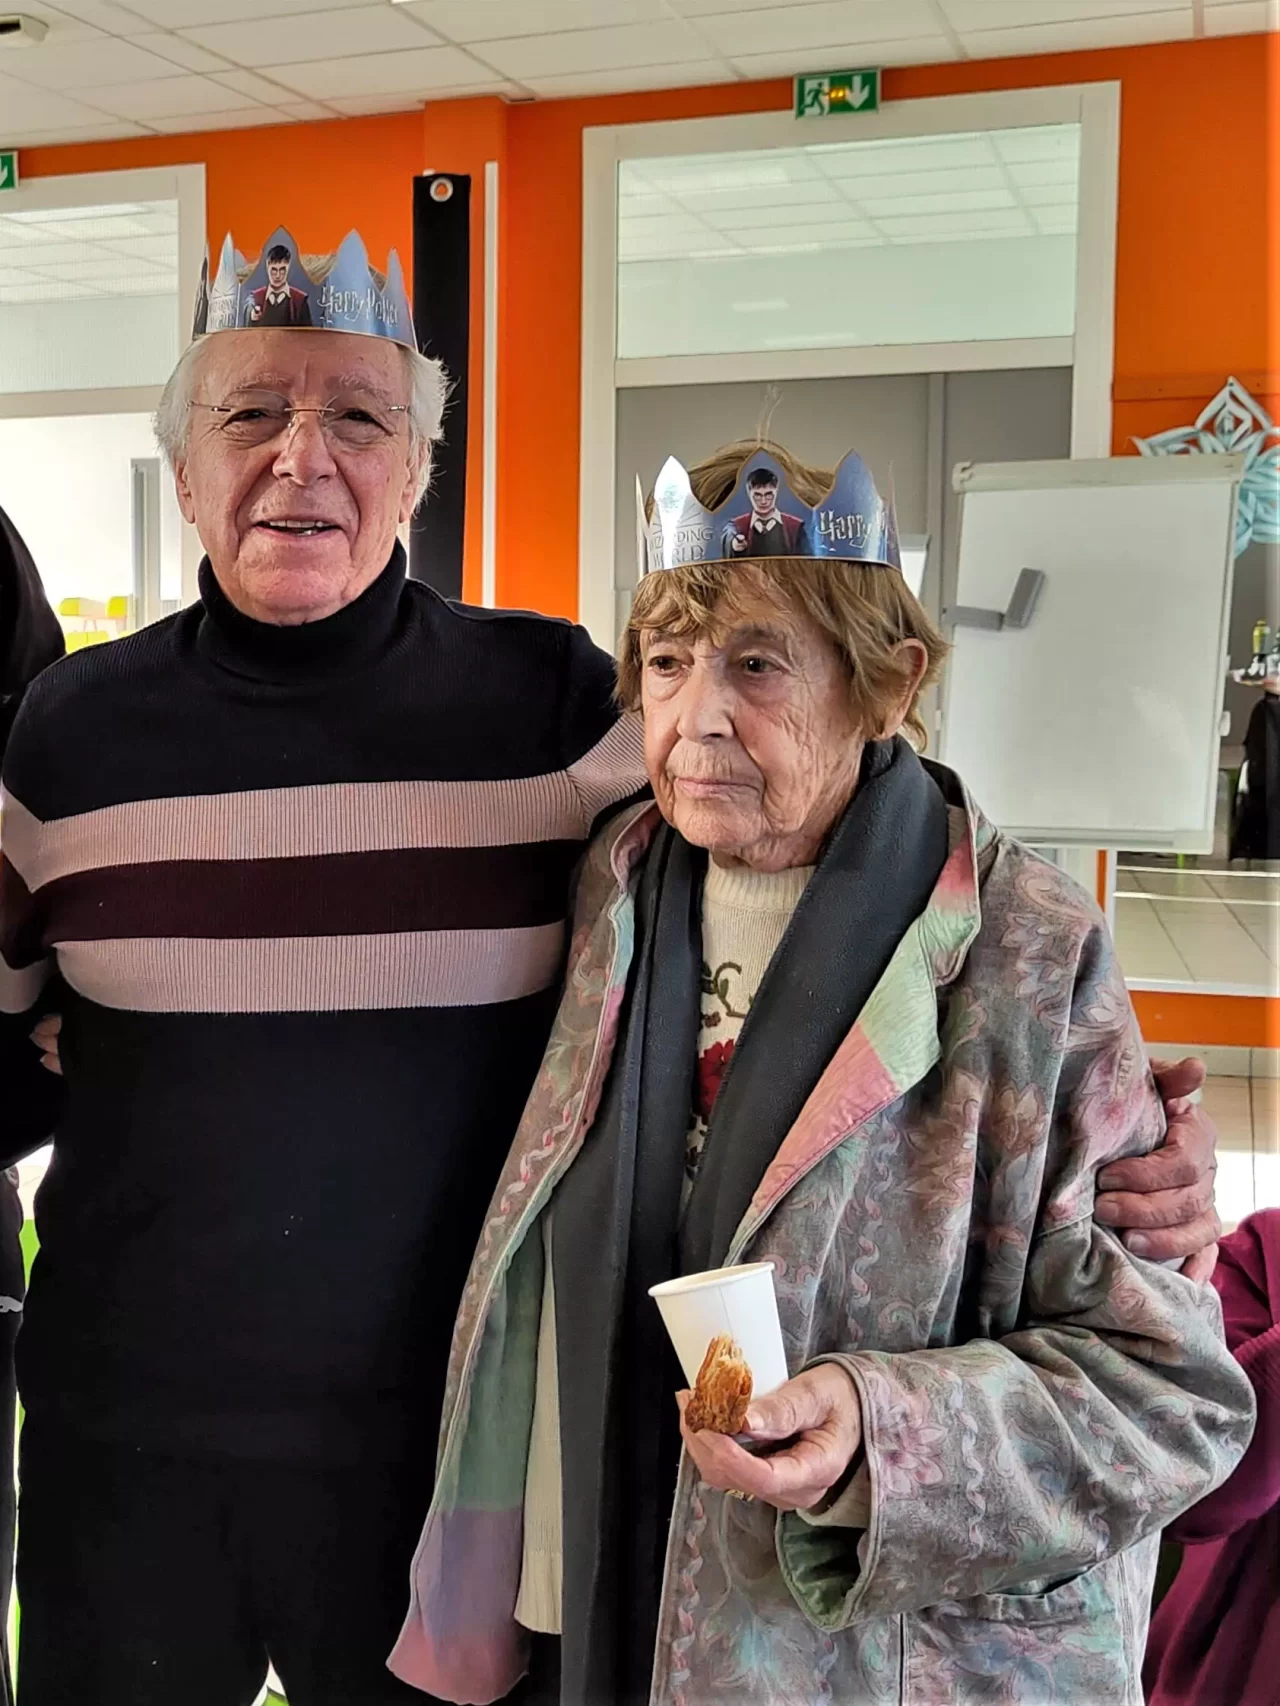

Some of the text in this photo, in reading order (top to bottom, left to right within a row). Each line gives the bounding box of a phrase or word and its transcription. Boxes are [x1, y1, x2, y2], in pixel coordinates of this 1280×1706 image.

[317, 285, 399, 327] Harry Potter
[815, 509, 872, 552] Harry
